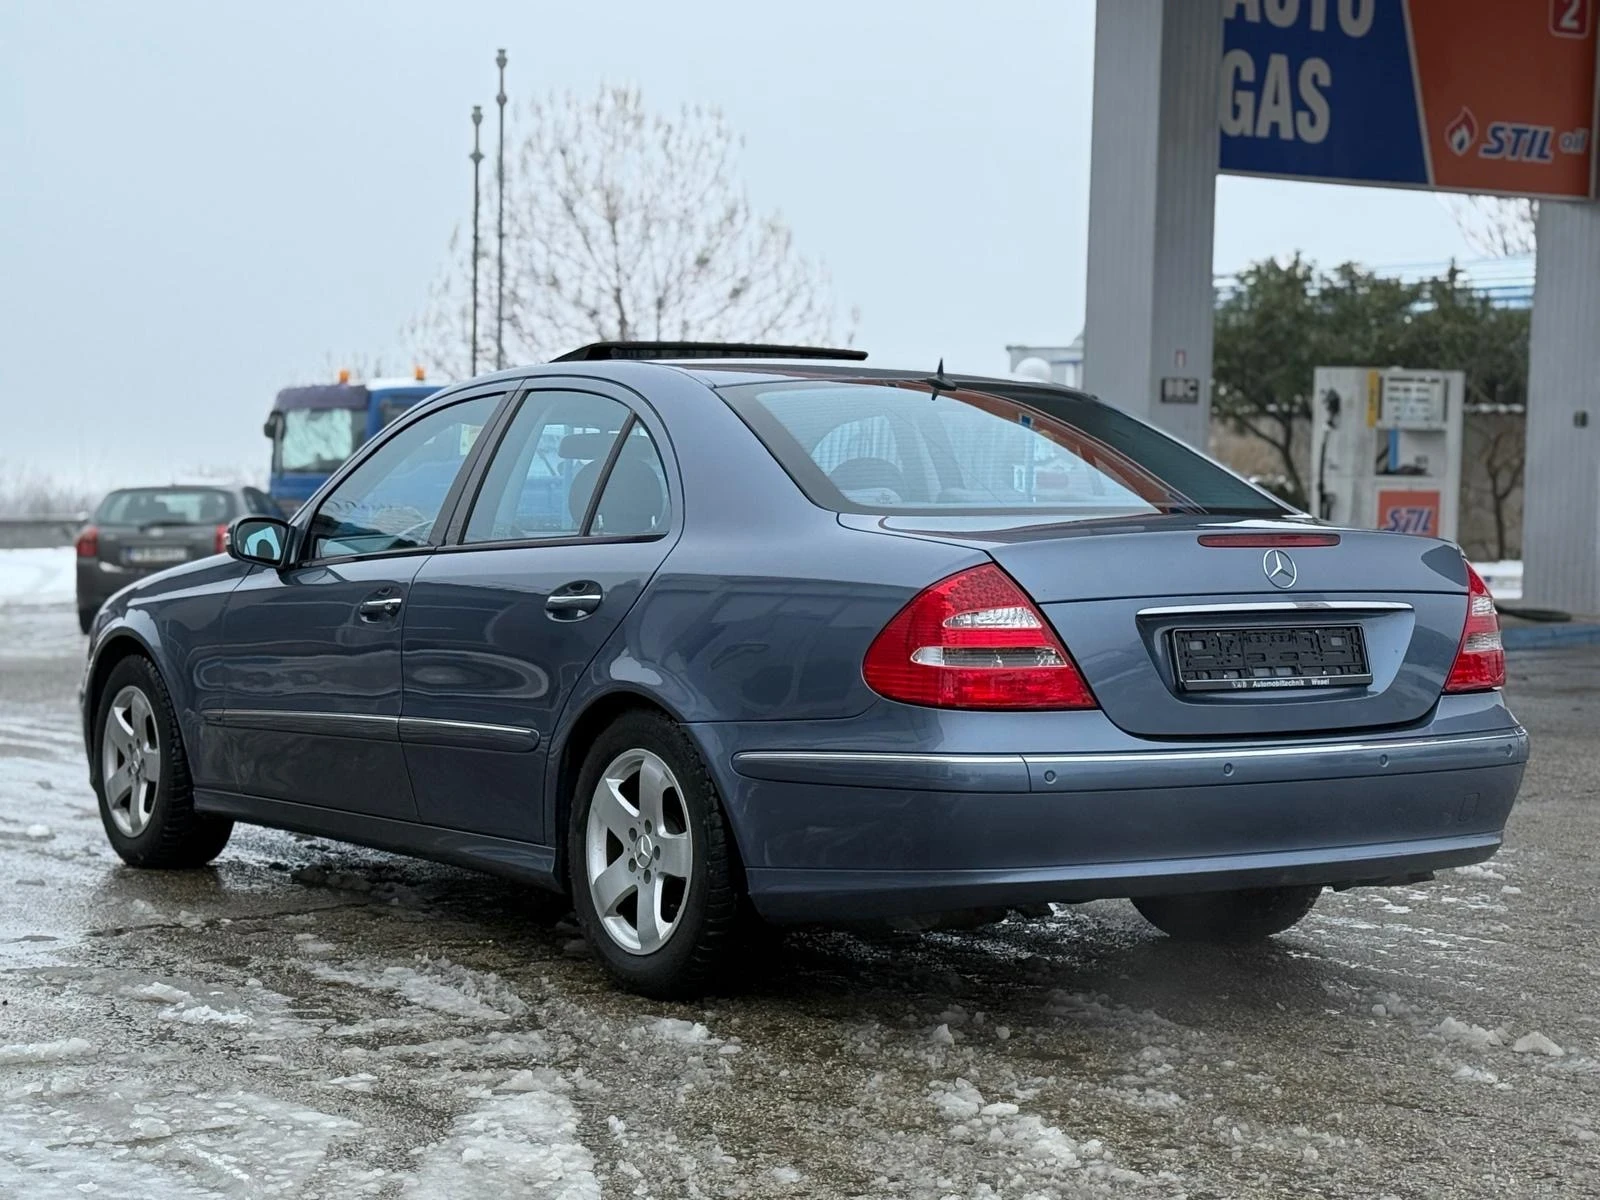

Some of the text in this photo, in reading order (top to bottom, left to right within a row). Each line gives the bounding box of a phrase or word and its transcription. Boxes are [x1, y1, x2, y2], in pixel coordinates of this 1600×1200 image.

[1559, 0, 1581, 28] 2
[1218, 48, 1332, 144] GAS
[1480, 122, 1588, 162] STIL oil
[1385, 507, 1432, 533] STIL
[1252, 679, 1305, 688] Automobiltechnik
